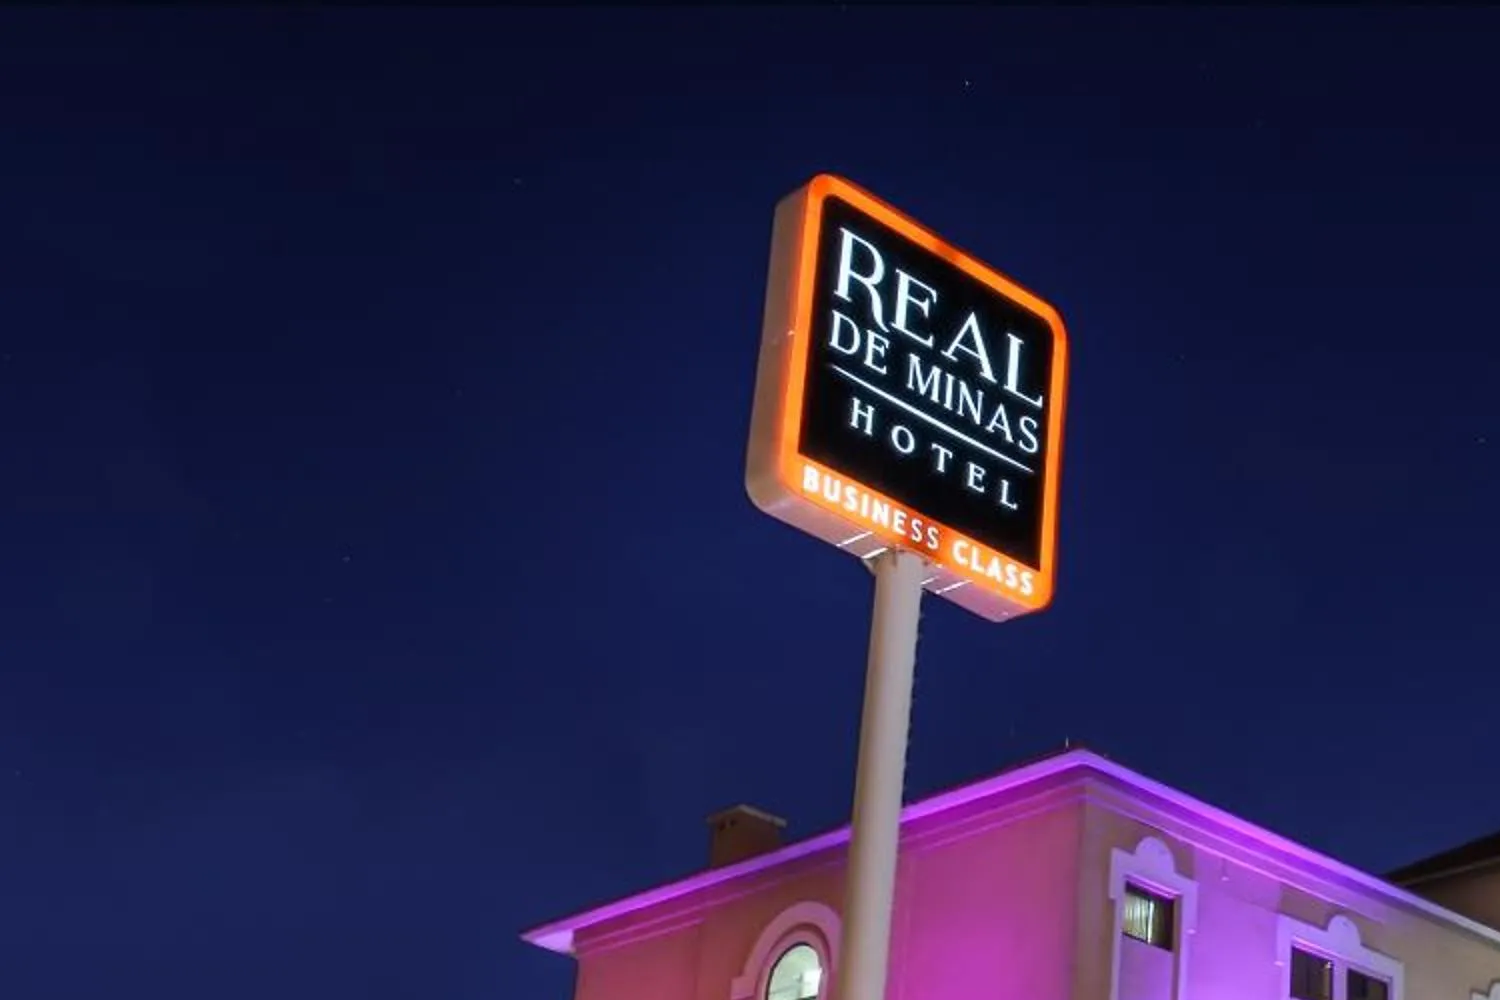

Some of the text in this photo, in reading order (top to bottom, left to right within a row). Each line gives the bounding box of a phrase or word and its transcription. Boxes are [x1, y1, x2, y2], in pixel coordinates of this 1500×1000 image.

[828, 309, 1040, 453] DE MINAS
[833, 226, 1044, 409] REAL
[850, 397, 1018, 509] HOTEL
[802, 464, 1034, 596] BUSINESS CLASS
